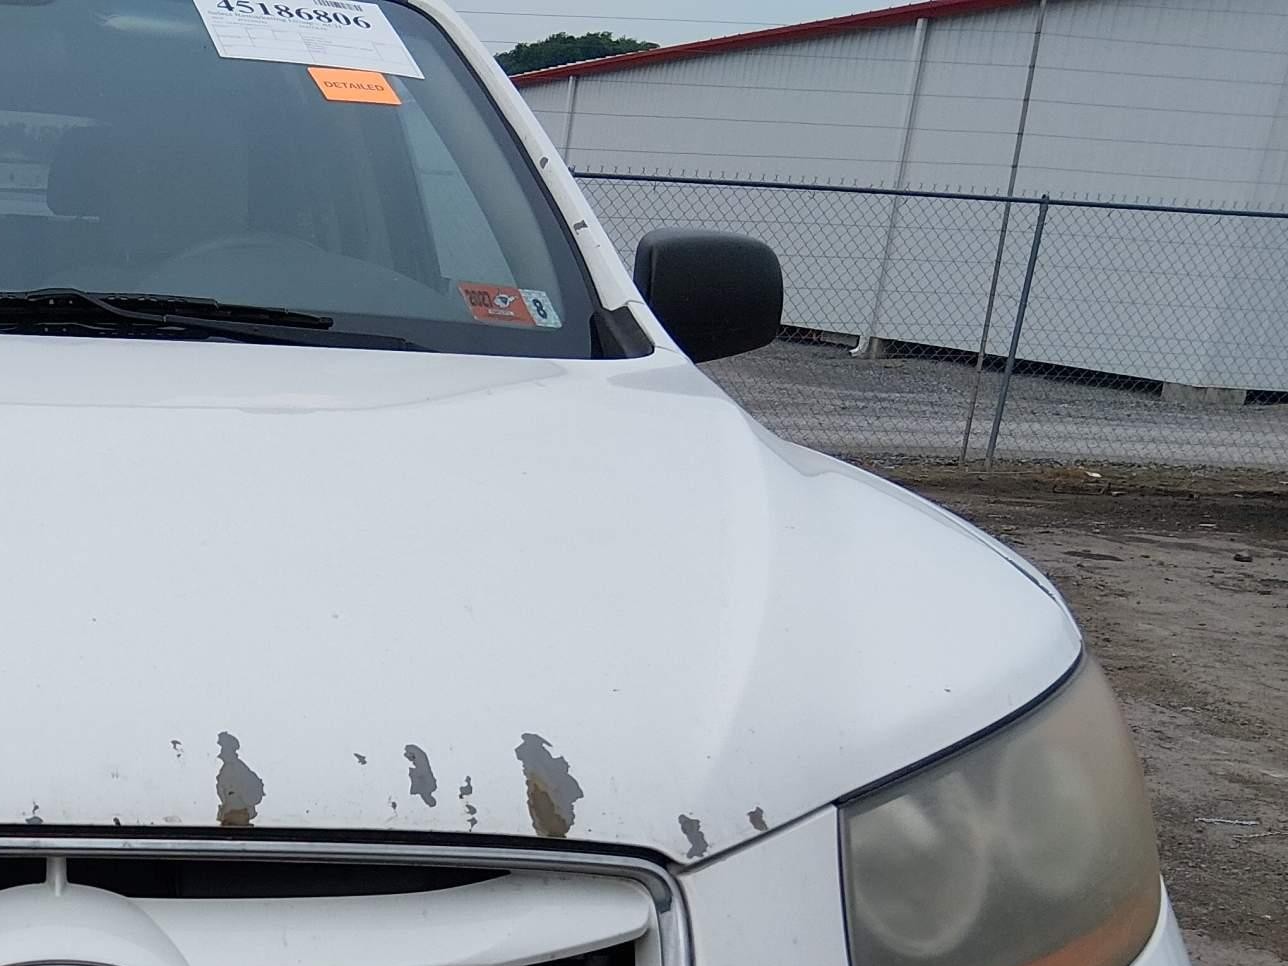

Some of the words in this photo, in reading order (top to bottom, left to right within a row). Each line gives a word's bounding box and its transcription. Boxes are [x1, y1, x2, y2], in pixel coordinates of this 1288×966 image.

[216, 0, 372, 30] 45186806
[324, 80, 385, 93] DETAILED
[532, 298, 547, 320] 8
